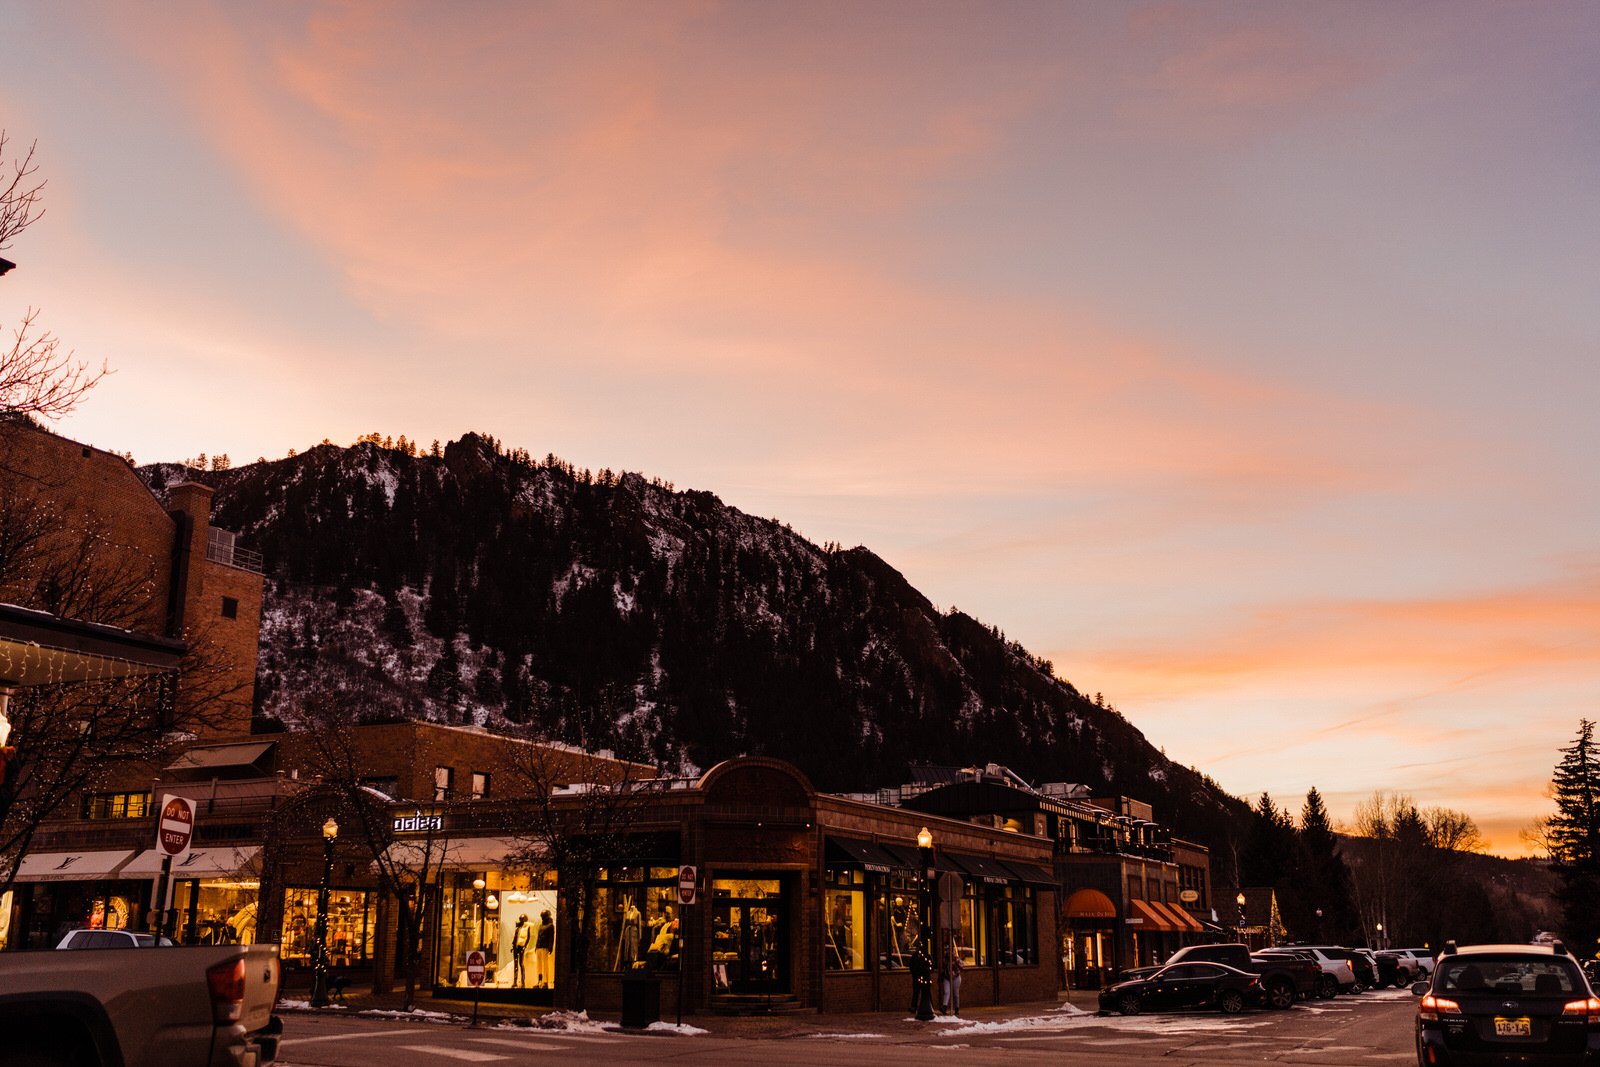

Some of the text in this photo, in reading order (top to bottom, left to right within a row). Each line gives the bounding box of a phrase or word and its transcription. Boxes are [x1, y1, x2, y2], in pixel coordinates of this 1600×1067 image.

[166, 807, 190, 820] DO NOT
[165, 833, 184, 845] ENTER
